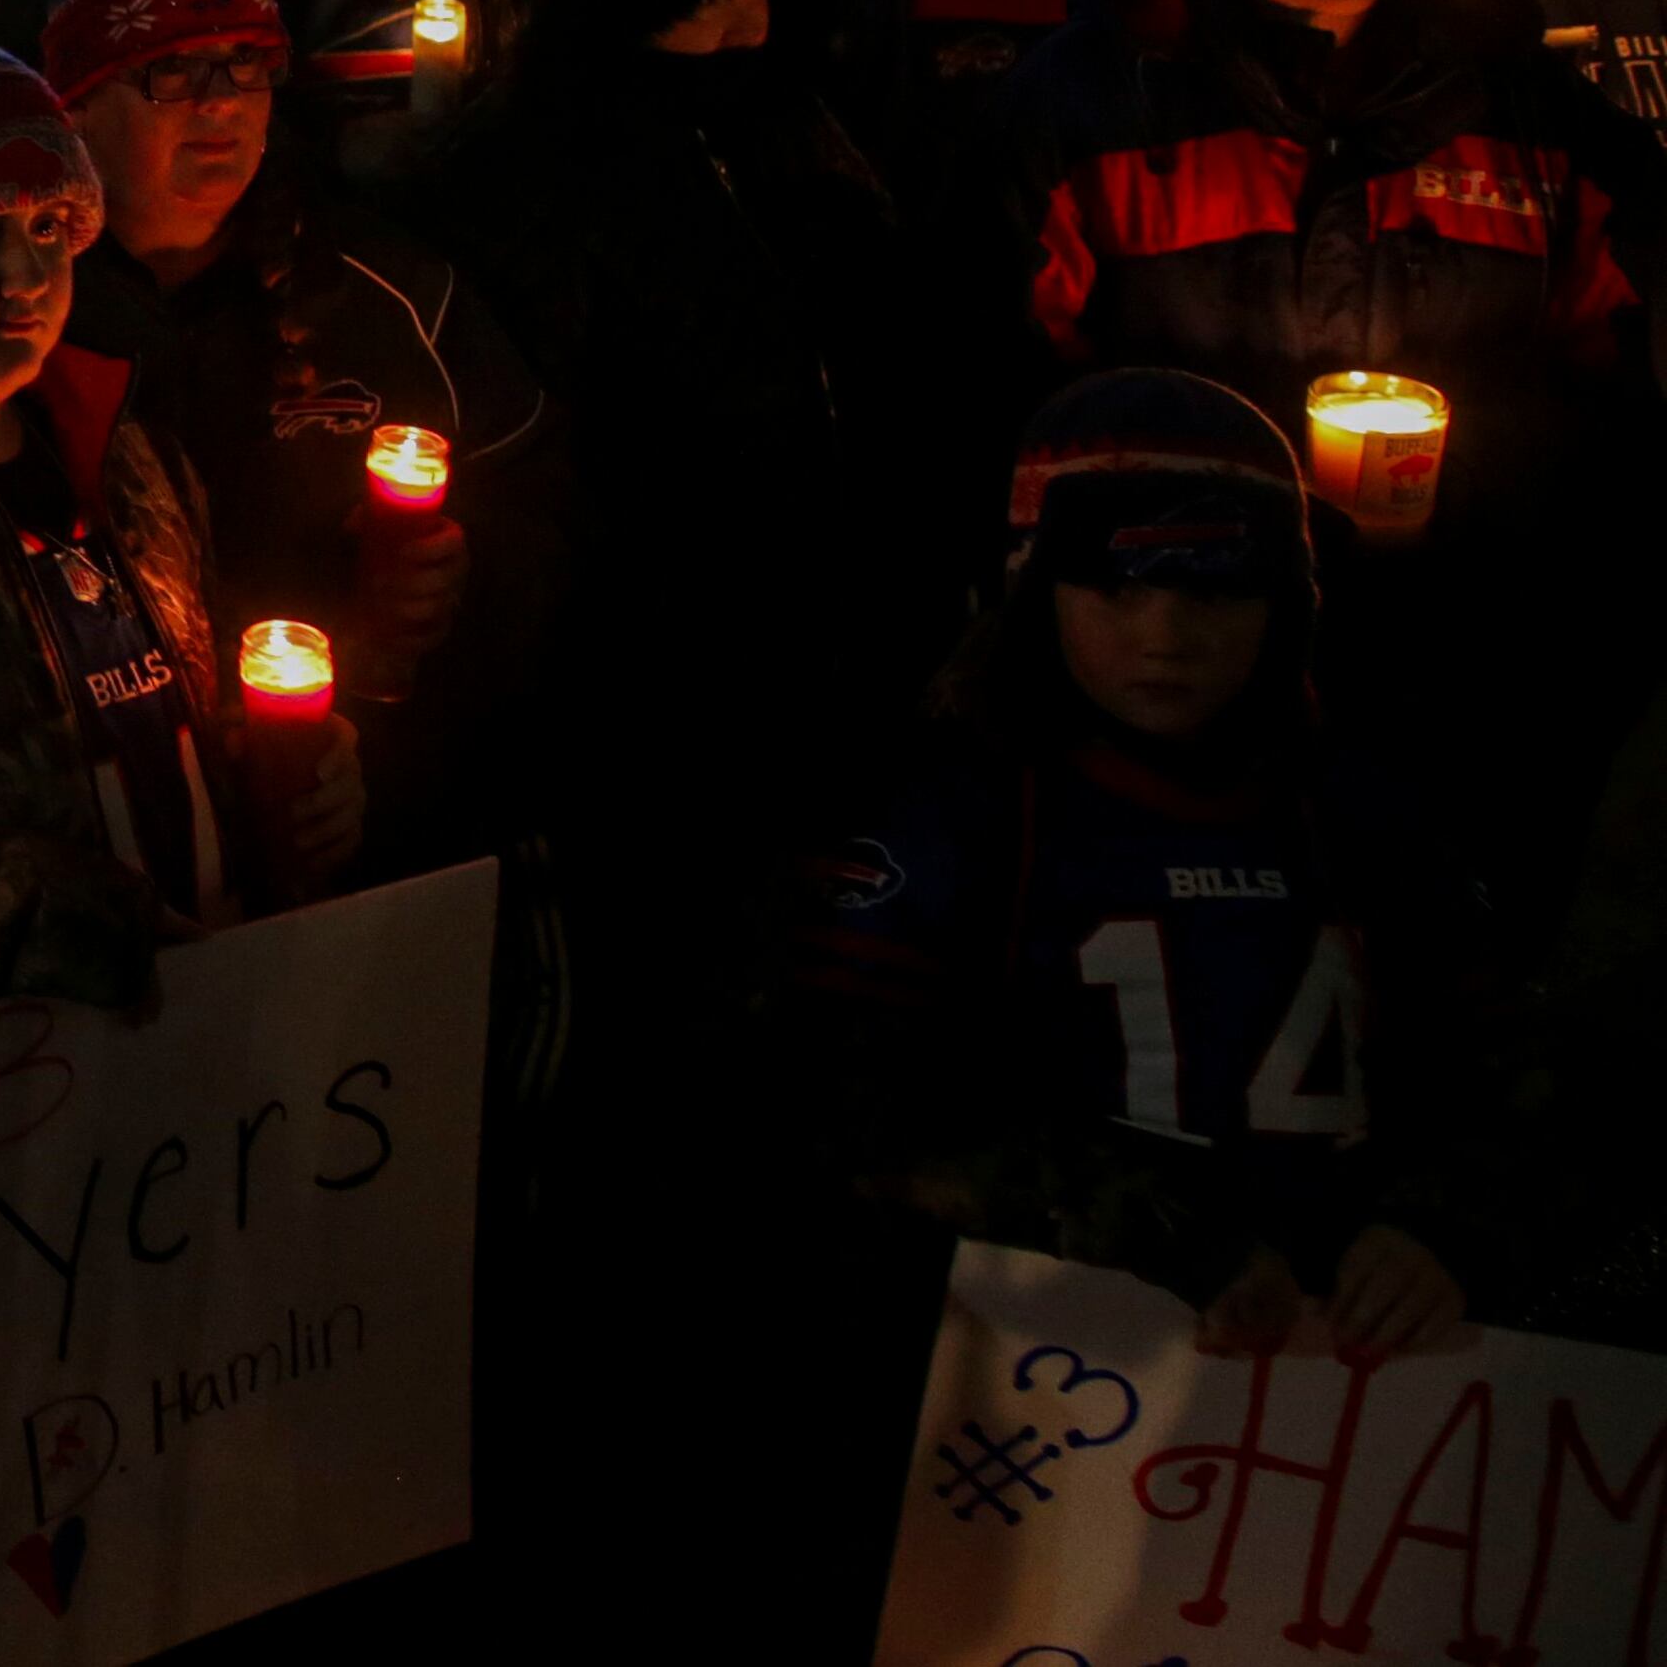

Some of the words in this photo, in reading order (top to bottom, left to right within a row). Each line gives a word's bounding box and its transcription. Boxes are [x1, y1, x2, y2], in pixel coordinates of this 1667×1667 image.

[85, 650, 175, 707] BILLS
[1165, 865, 1290, 903] BILLS
[1074, 910, 1373, 1152] 14
[153, 1302, 366, 1455] Hamlin
